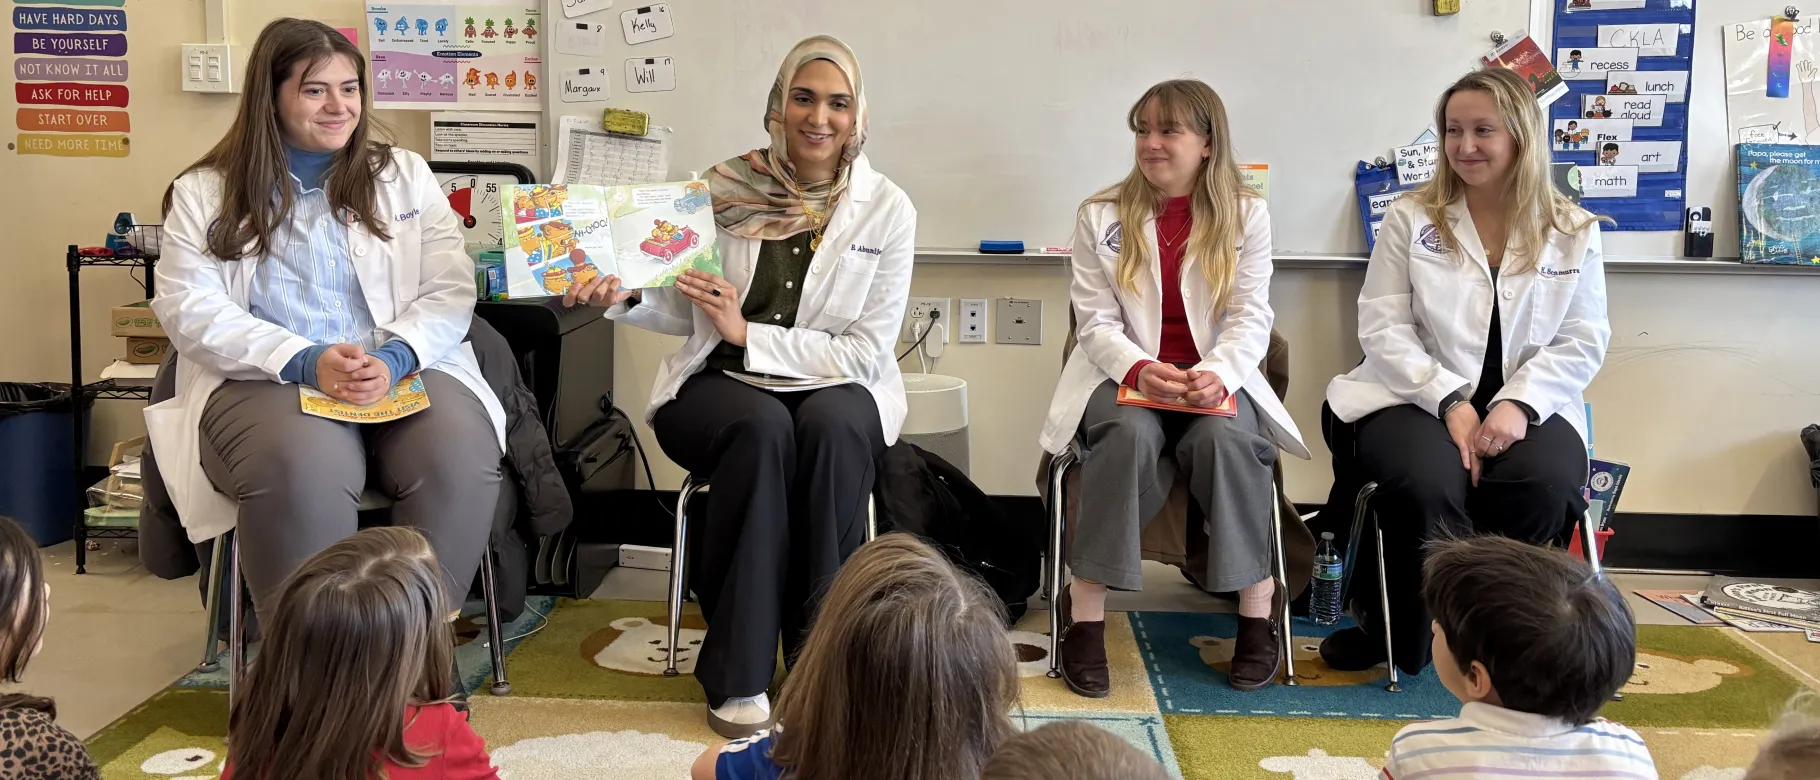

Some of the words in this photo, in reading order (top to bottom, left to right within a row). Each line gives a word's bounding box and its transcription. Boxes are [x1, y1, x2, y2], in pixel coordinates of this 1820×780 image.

[19, 13, 48, 25] HAVE
[52, 13, 84, 25] HARD
[89, 14, 119, 25] DAYS
[596, 25, 603, 33] 8
[631, 18, 657, 33] Kelly
[1735, 24, 1755, 41] Be
[1793, 18, 1811, 35] ood
[1610, 28, 1664, 48] CKLA
[32, 38, 46, 49] BE
[51, 38, 108, 50] YOURSELF
[19, 63, 41, 75] NOT
[46, 63, 80, 75] KNOW
[85, 64, 98, 75] IT
[103, 64, 123, 76] ALL
[1591, 61, 1629, 70] recess
[634, 66, 656, 85] Will
[564, 80, 601, 96] Margaux
[1645, 81, 1674, 92] lunch
[31, 88, 53, 100] ASK
[57, 88, 80, 100] FOR
[85, 89, 112, 101] HELP
[1624, 99, 1651, 109] read
[38, 113, 72, 125] START
[76, 114, 108, 126] OVER
[1620, 110, 1651, 120] aloud
[1597, 133, 1618, 141] Flex
[24, 139, 53, 150] NEED
[57, 139, 90, 150] MORE
[95, 139, 124, 151] TIME
[1400, 148, 1421, 157] Sun,
[1641, 153, 1662, 162] art
[1407, 160, 1415, 169] &
[1402, 170, 1430, 182] Word
[1595, 176, 1627, 186] math
[451, 183, 456, 192] 5
[470, 178, 475, 188] 0
[486, 183, 497, 193] 55
[400, 207, 420, 221] Boyle
[397, 401, 420, 411] VISIT
[328, 408, 371, 417] DENTIST
